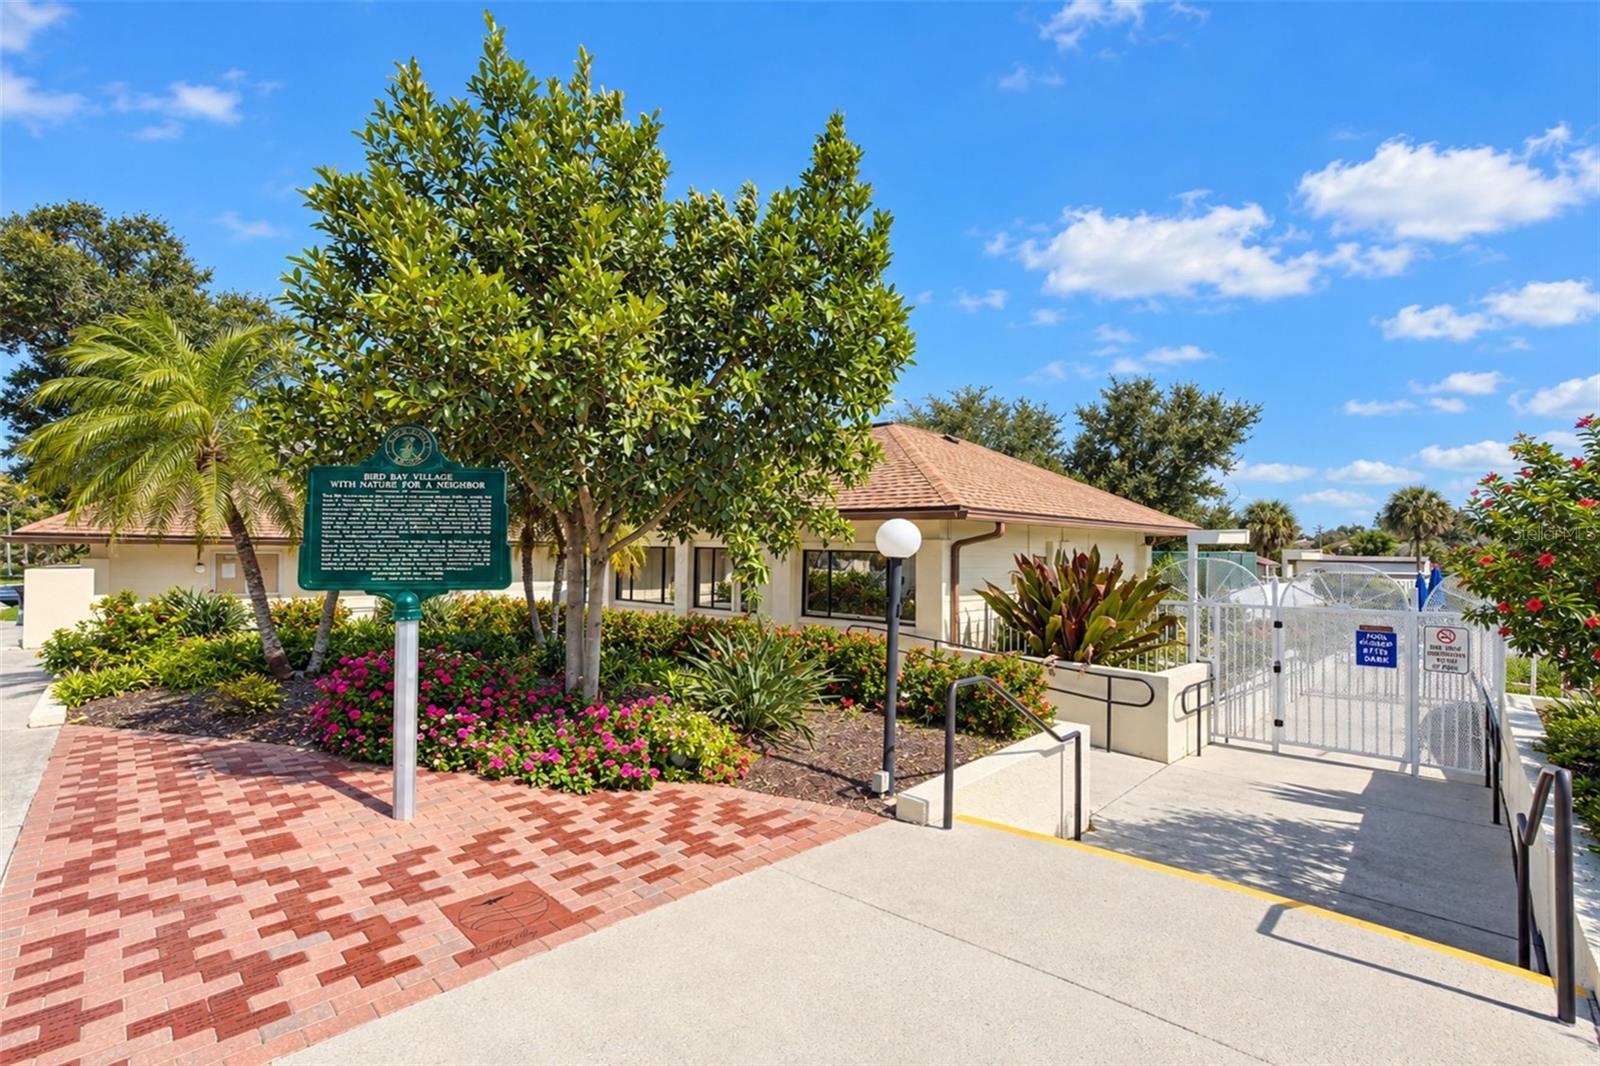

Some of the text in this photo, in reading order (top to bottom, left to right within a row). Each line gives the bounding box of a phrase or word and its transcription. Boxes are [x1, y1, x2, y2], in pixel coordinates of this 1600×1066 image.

[363, 473, 453, 481] BIRD BAY VILLAGE
[330, 480, 356, 488] WITH
[402, 481, 421, 489] FOR
[425, 481, 433, 489] A
[436, 481, 486, 489] NEIGHBOR
[1363, 655, 1390, 664] DARK
